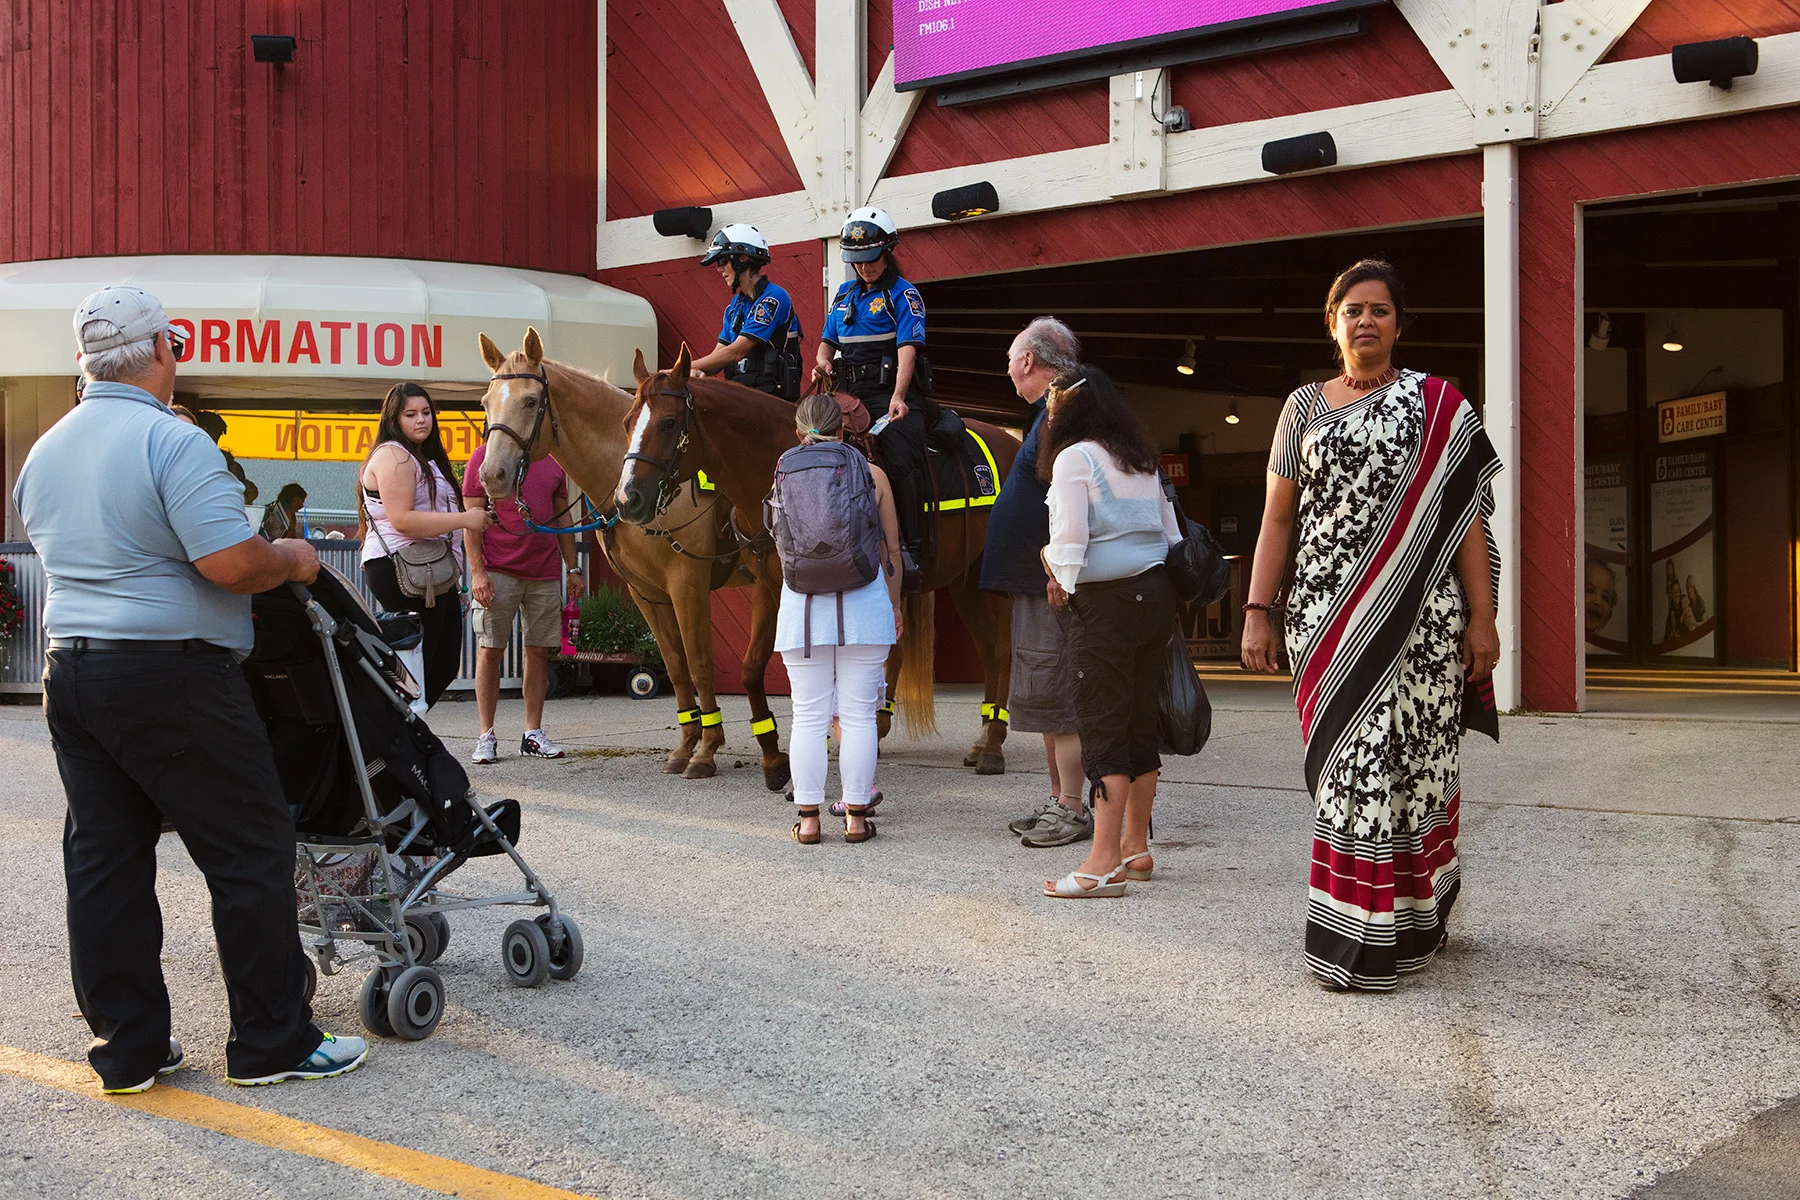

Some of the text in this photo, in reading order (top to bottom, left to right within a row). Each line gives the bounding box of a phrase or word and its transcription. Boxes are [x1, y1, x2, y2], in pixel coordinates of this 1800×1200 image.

[918, 17, 955, 36] FM106.1
[1676, 398, 1723, 418] FAMILY/BABY
[1676, 415, 1724, 433] CARE CENTER
[1593, 476, 1620, 487] CENTER
[1667, 466, 1707, 479] CARE CENTER
